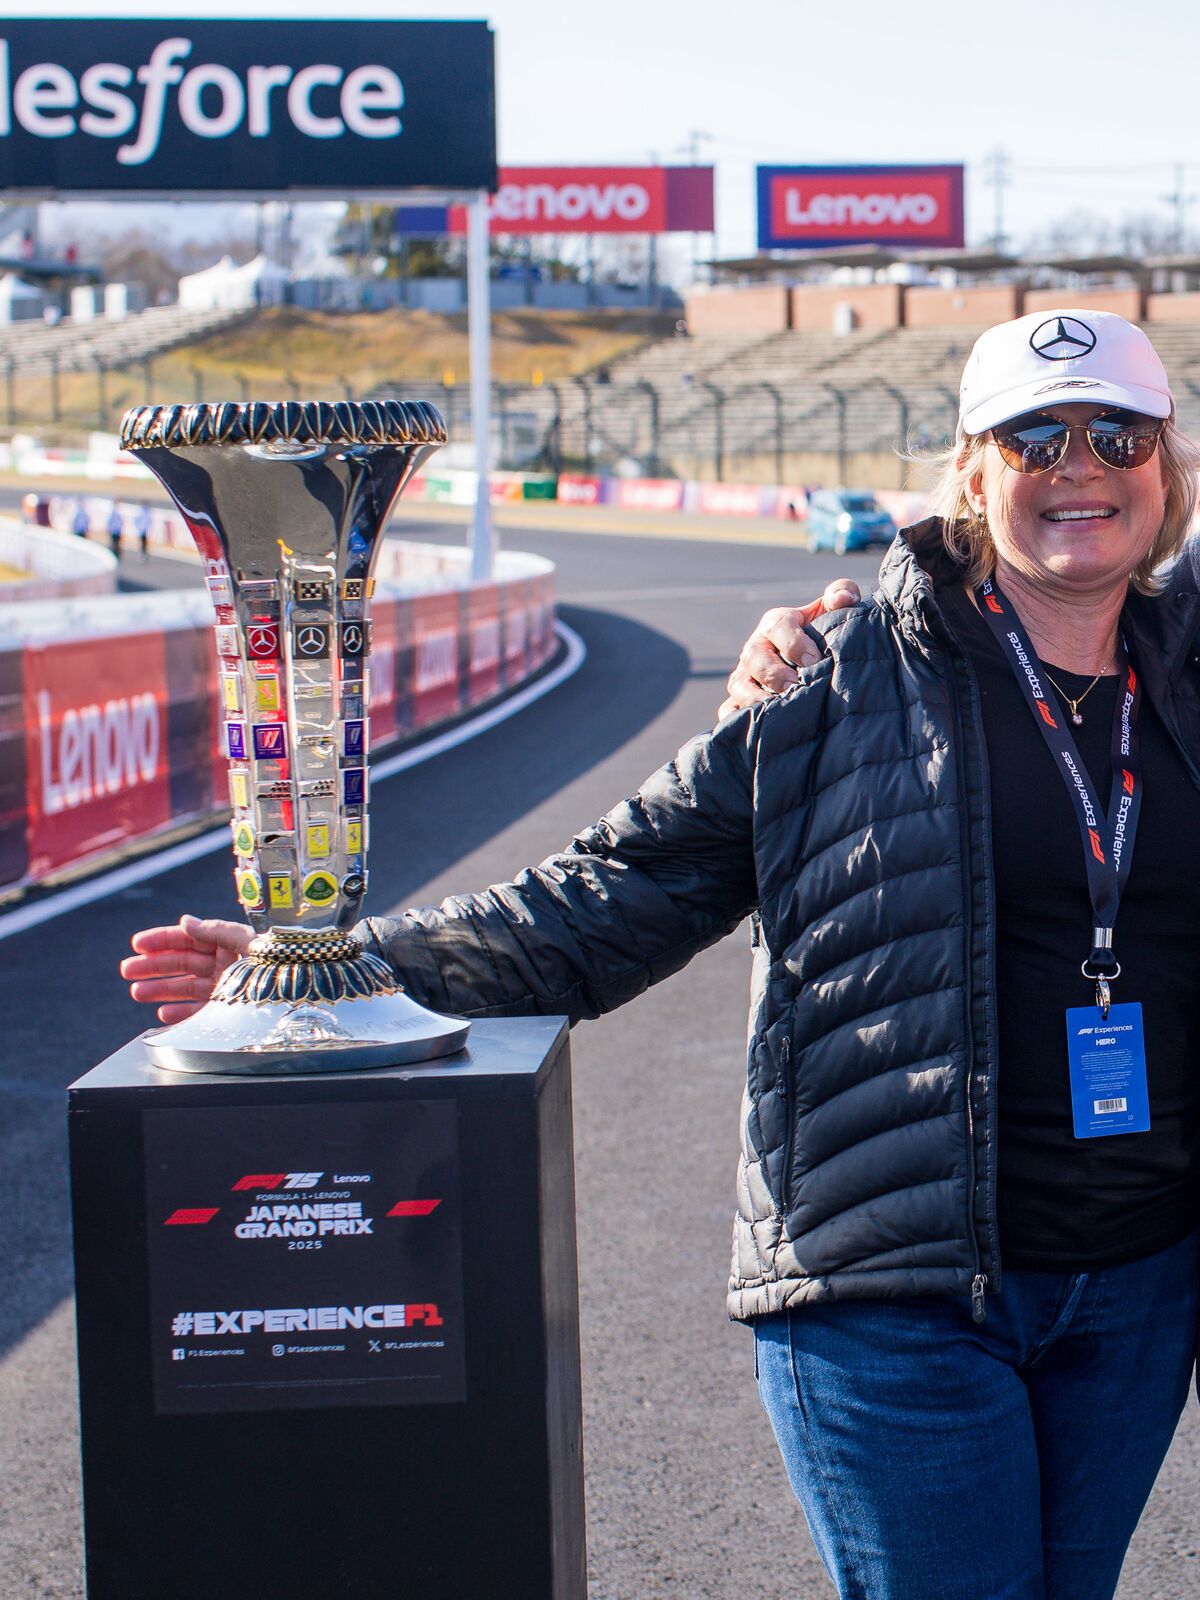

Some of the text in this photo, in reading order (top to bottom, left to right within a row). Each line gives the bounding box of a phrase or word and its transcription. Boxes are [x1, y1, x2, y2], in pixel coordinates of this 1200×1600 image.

[488, 183, 649, 220] enovo
[785, 189, 937, 226] Lenovo
[1007, 631, 1044, 699] Experiences
[1121, 691, 1134, 757] Experiences
[38, 690, 159, 815] Lenovo
[1061, 751, 1097, 827] Experiences
[1094, 1024, 1133, 1034] Experiences
[1095, 1037, 1117, 1046] HERO
[282, 1172, 325, 1189] 75
[333, 1173, 371, 1184] Lenovo
[256, 1192, 300, 1202] FORMULA
[314, 1190, 351, 1200] LENOVO
[245, 1201, 362, 1222] JAPANESE
[234, 1217, 374, 1239] GRAND PRIX
[287, 1240, 323, 1250] 2025
[171, 1303, 444, 1337] #EXPERIENCEF1
